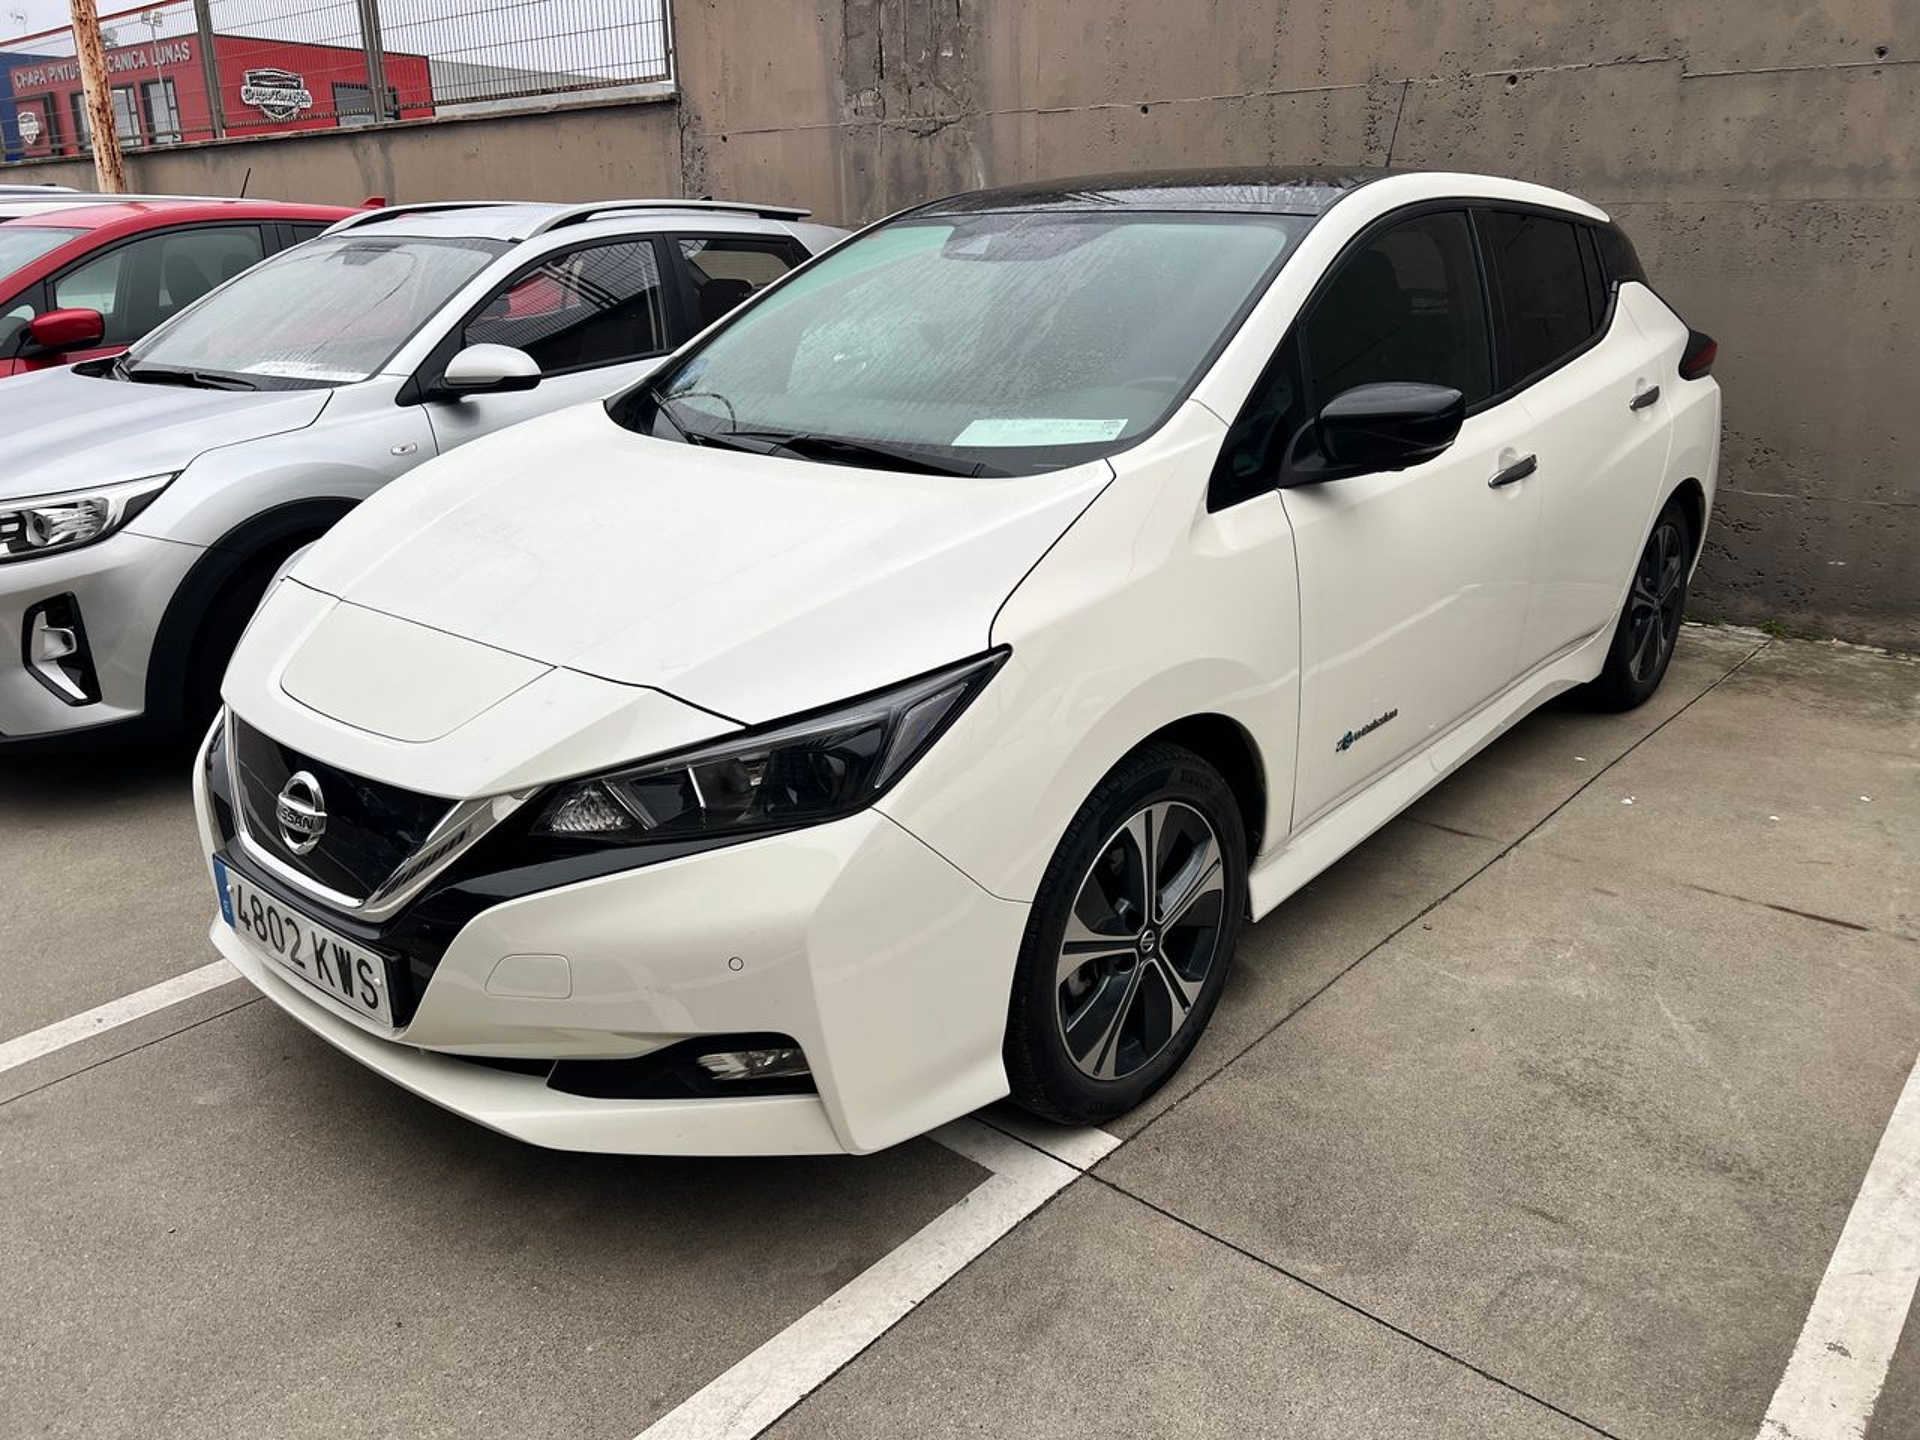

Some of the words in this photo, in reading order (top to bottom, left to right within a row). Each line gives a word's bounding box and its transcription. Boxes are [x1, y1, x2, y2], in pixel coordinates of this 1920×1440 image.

[15, 69, 47, 88] CHAPA
[106, 50, 148, 73] CANICA
[150, 41, 190, 66] LUNAS
[236, 884, 306, 969] 4802
[311, 931, 379, 1010] KWS
